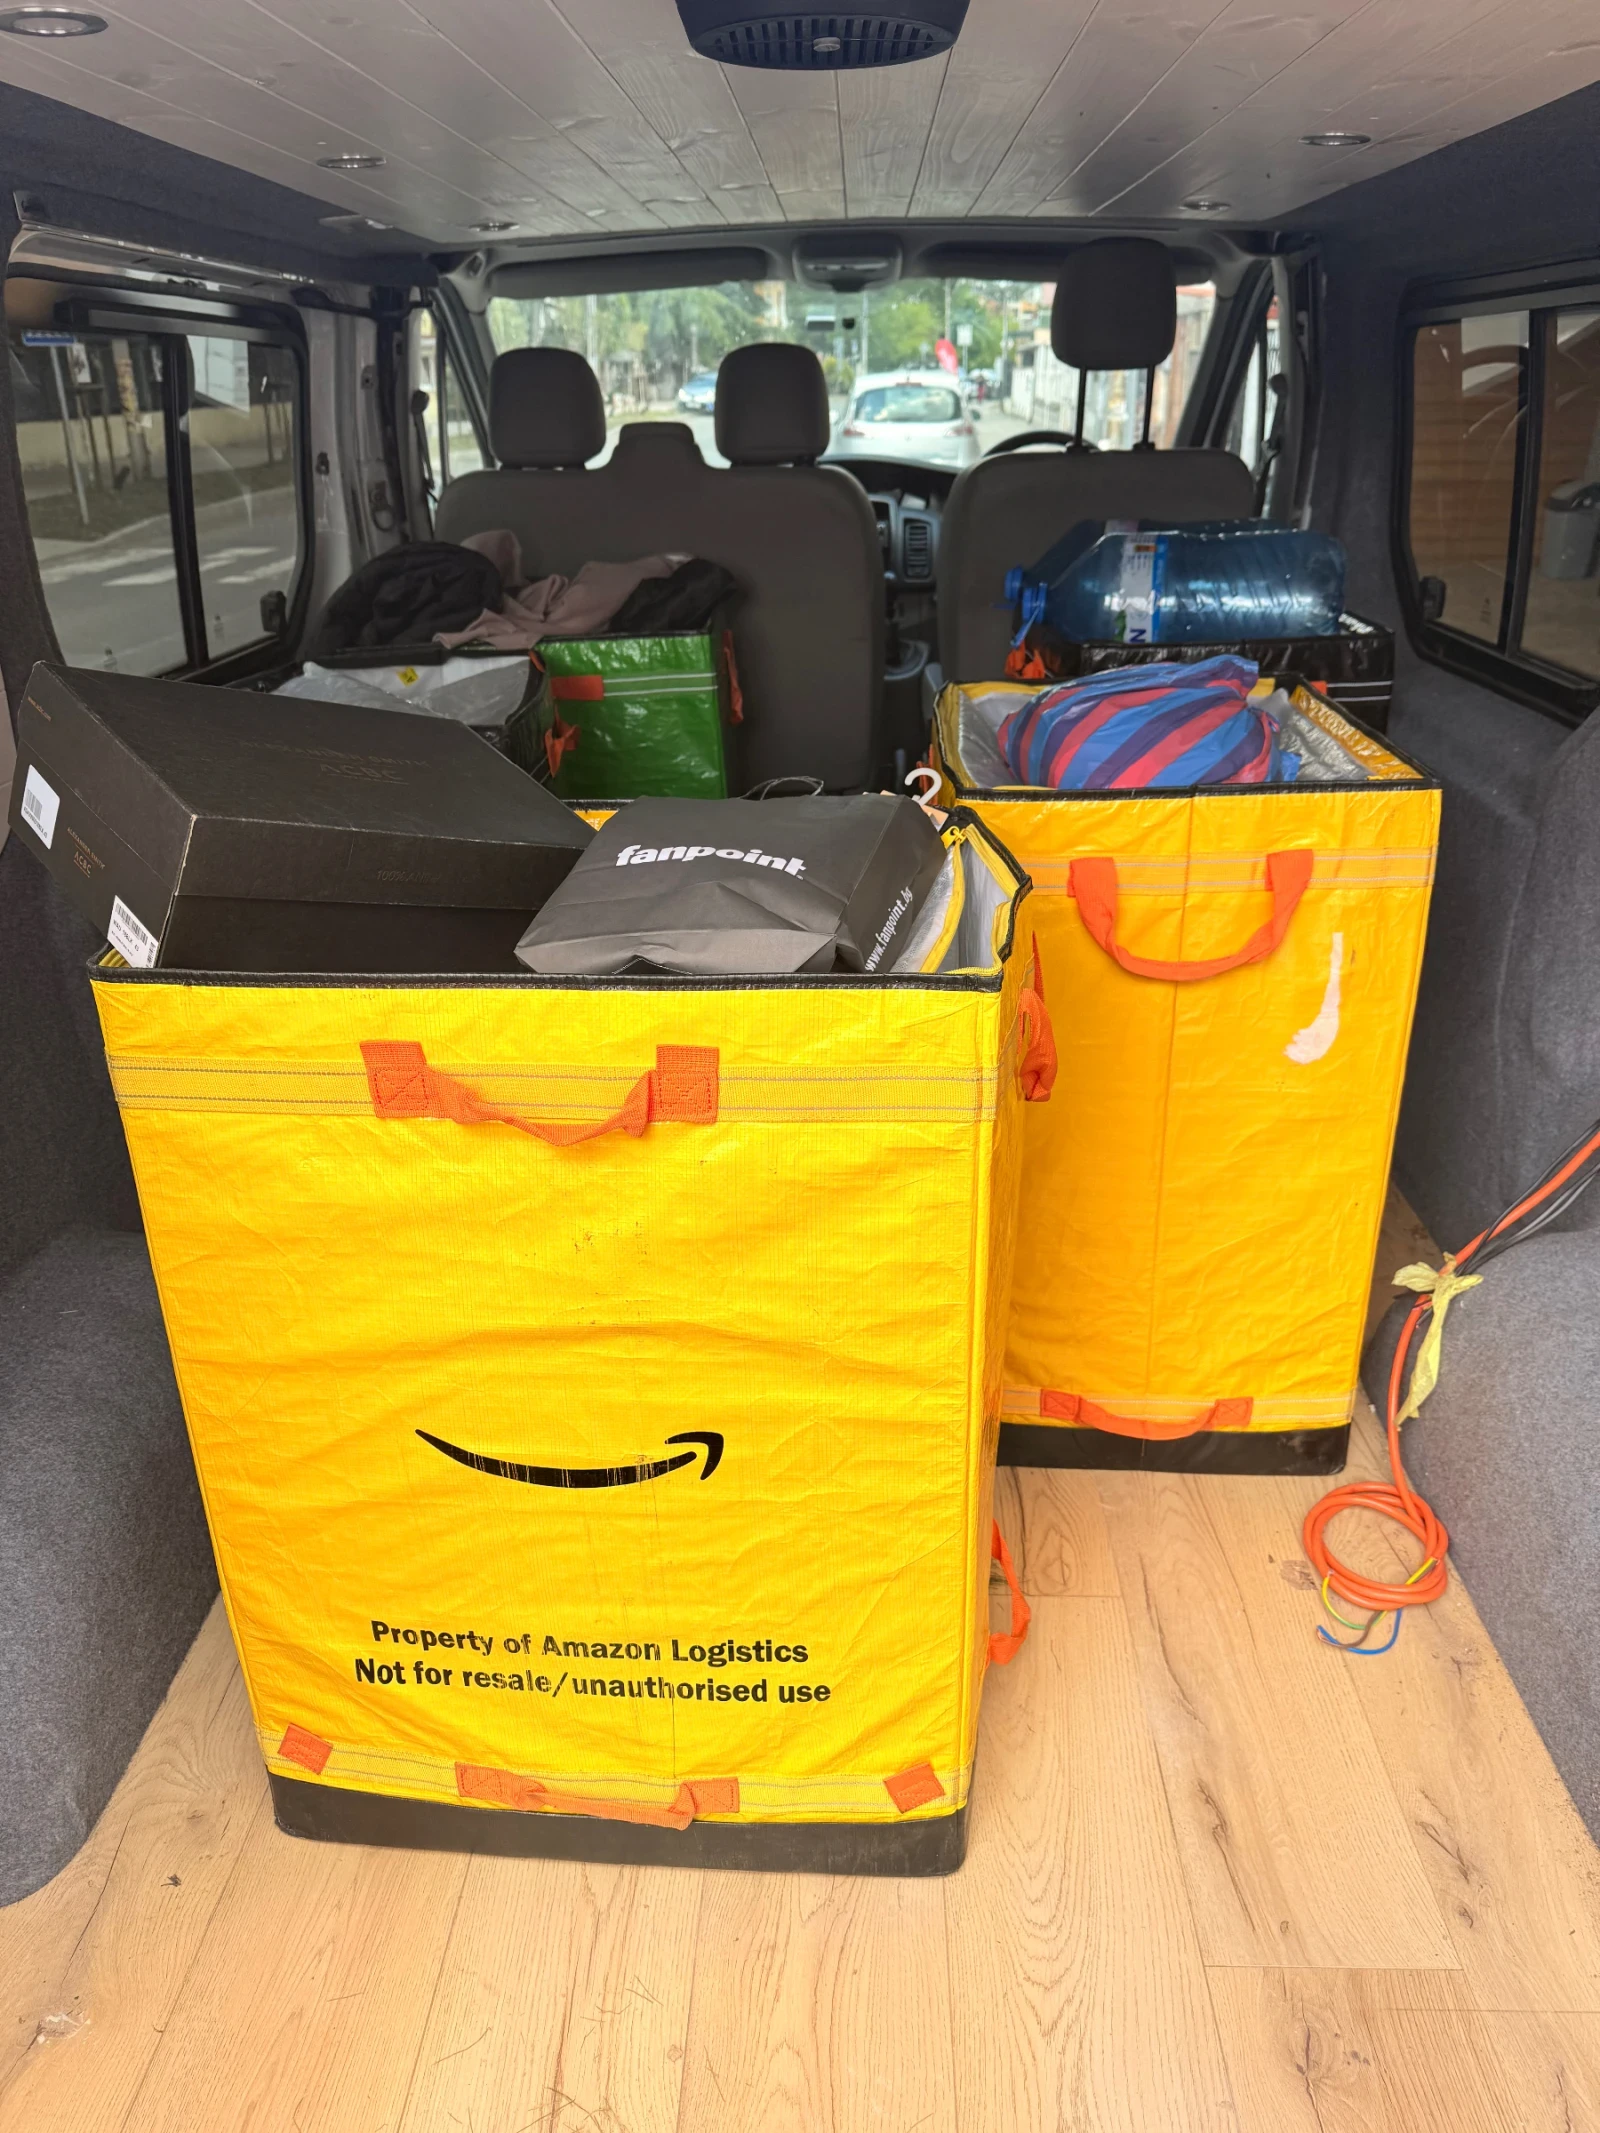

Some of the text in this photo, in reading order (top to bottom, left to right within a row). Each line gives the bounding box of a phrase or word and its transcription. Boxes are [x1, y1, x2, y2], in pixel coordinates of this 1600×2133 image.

[615, 844, 807, 876] fanpoint
[864, 886, 914, 972] www.fanpoint.bg
[371, 1620, 809, 1668] Property of Amazon Logistics
[354, 1658, 831, 1703] Not for resale/unauthorised use
